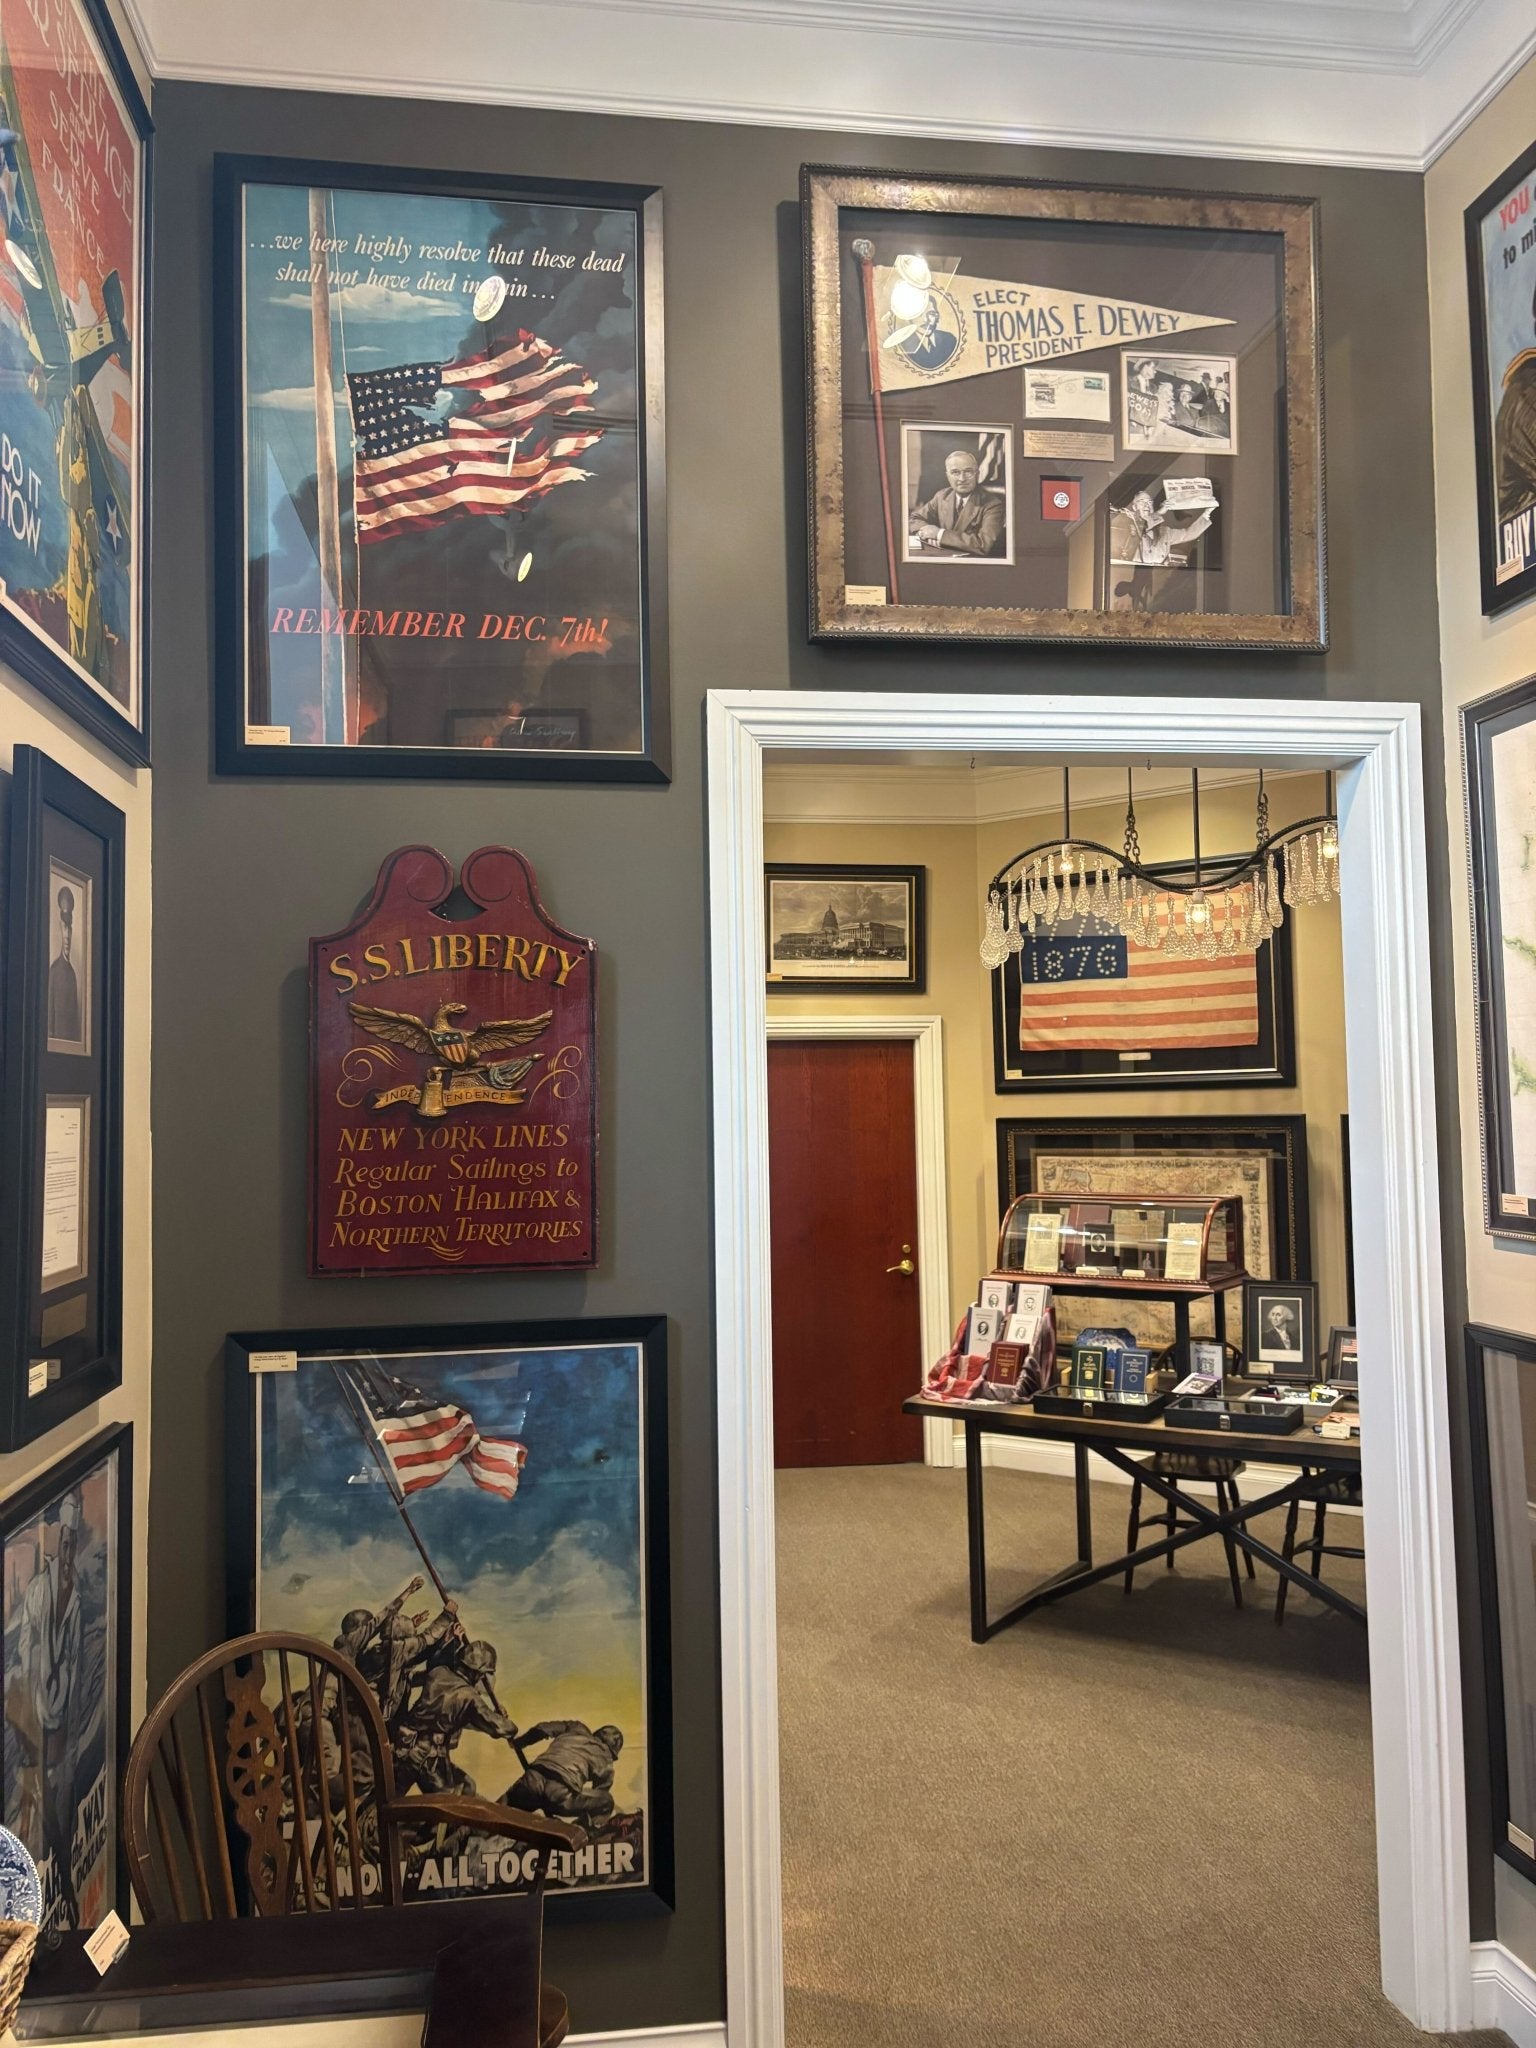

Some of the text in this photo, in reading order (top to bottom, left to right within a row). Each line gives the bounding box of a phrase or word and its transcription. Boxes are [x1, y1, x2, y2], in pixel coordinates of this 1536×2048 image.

[50, 90, 100, 215] SERVE
[42, 137, 105, 279] FRANCE
[1499, 185, 1531, 231] YOU
[309, 231, 348, 253] here
[354, 233, 412, 264] highly
[418, 240, 481, 262] resolve
[488, 244, 524, 266] that
[532, 247, 576, 270] these
[582, 250, 626, 273] dead
[1503, 245, 1517, 269] to
[275, 262, 323, 283] shall
[327, 268, 359, 286] not
[366, 268, 411, 289] have
[416, 270, 457, 292] died
[972, 289, 1031, 308] ELECT
[972, 303, 1180, 343] THOMAS E. DEWEY
[985, 336, 1084, 369] PRESIDENT
[2, 432, 42, 510] DO IT
[1, 474, 42, 557] NOW
[1503, 509, 1531, 563] BUY
[269, 607, 609, 647] REMEMBER DEC. 7th!
[1031, 944, 1117, 981] 1876
[337, 1124, 570, 1152] NEW YORK LINES
[333, 1154, 579, 1190] Regular Sailings to
[564, 1189, 581, 1210] &
[418, 1854, 474, 1890] ALL
